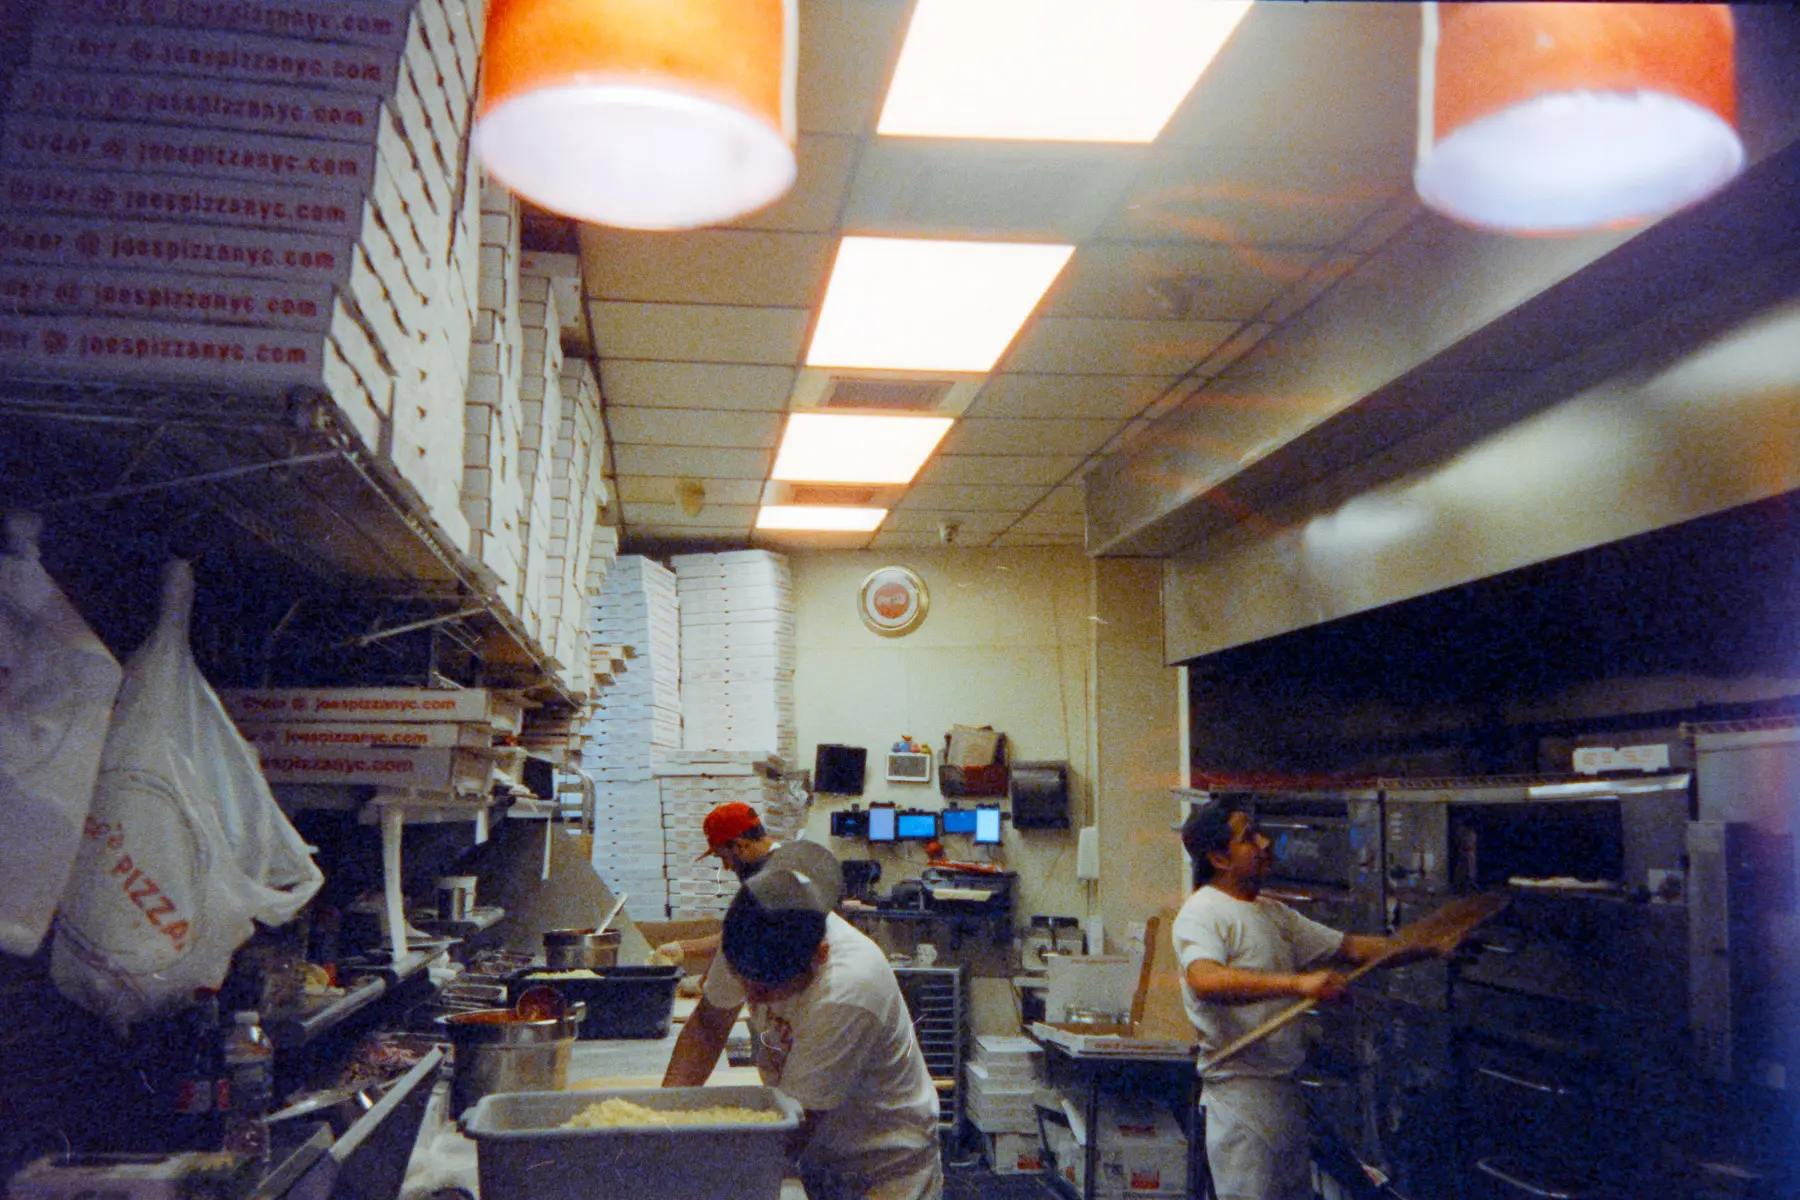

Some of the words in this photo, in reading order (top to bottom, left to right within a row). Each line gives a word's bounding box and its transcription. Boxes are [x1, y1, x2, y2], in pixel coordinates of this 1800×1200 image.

[163, 45, 382, 81] joespizzanyc.com
[145, 92, 364, 126] joespizzanyc.com
[102, 138, 127, 160] @
[139, 140, 358, 176] joespizzanyc.com
[89, 184, 115, 208] @
[126, 190, 347, 223] joespizzanyc.com
[76, 231, 100, 257] @
[112, 233, 335, 269] joespizzanyc.com
[95, 282, 318, 316] joespizzanyc.com
[79, 333, 307, 365] joespizzanyc.com
[315, 698, 457, 713] joespizzanyc.com
[284, 729, 429, 745] joespizzanyc.com
[111, 855, 188, 951] PIZZA
